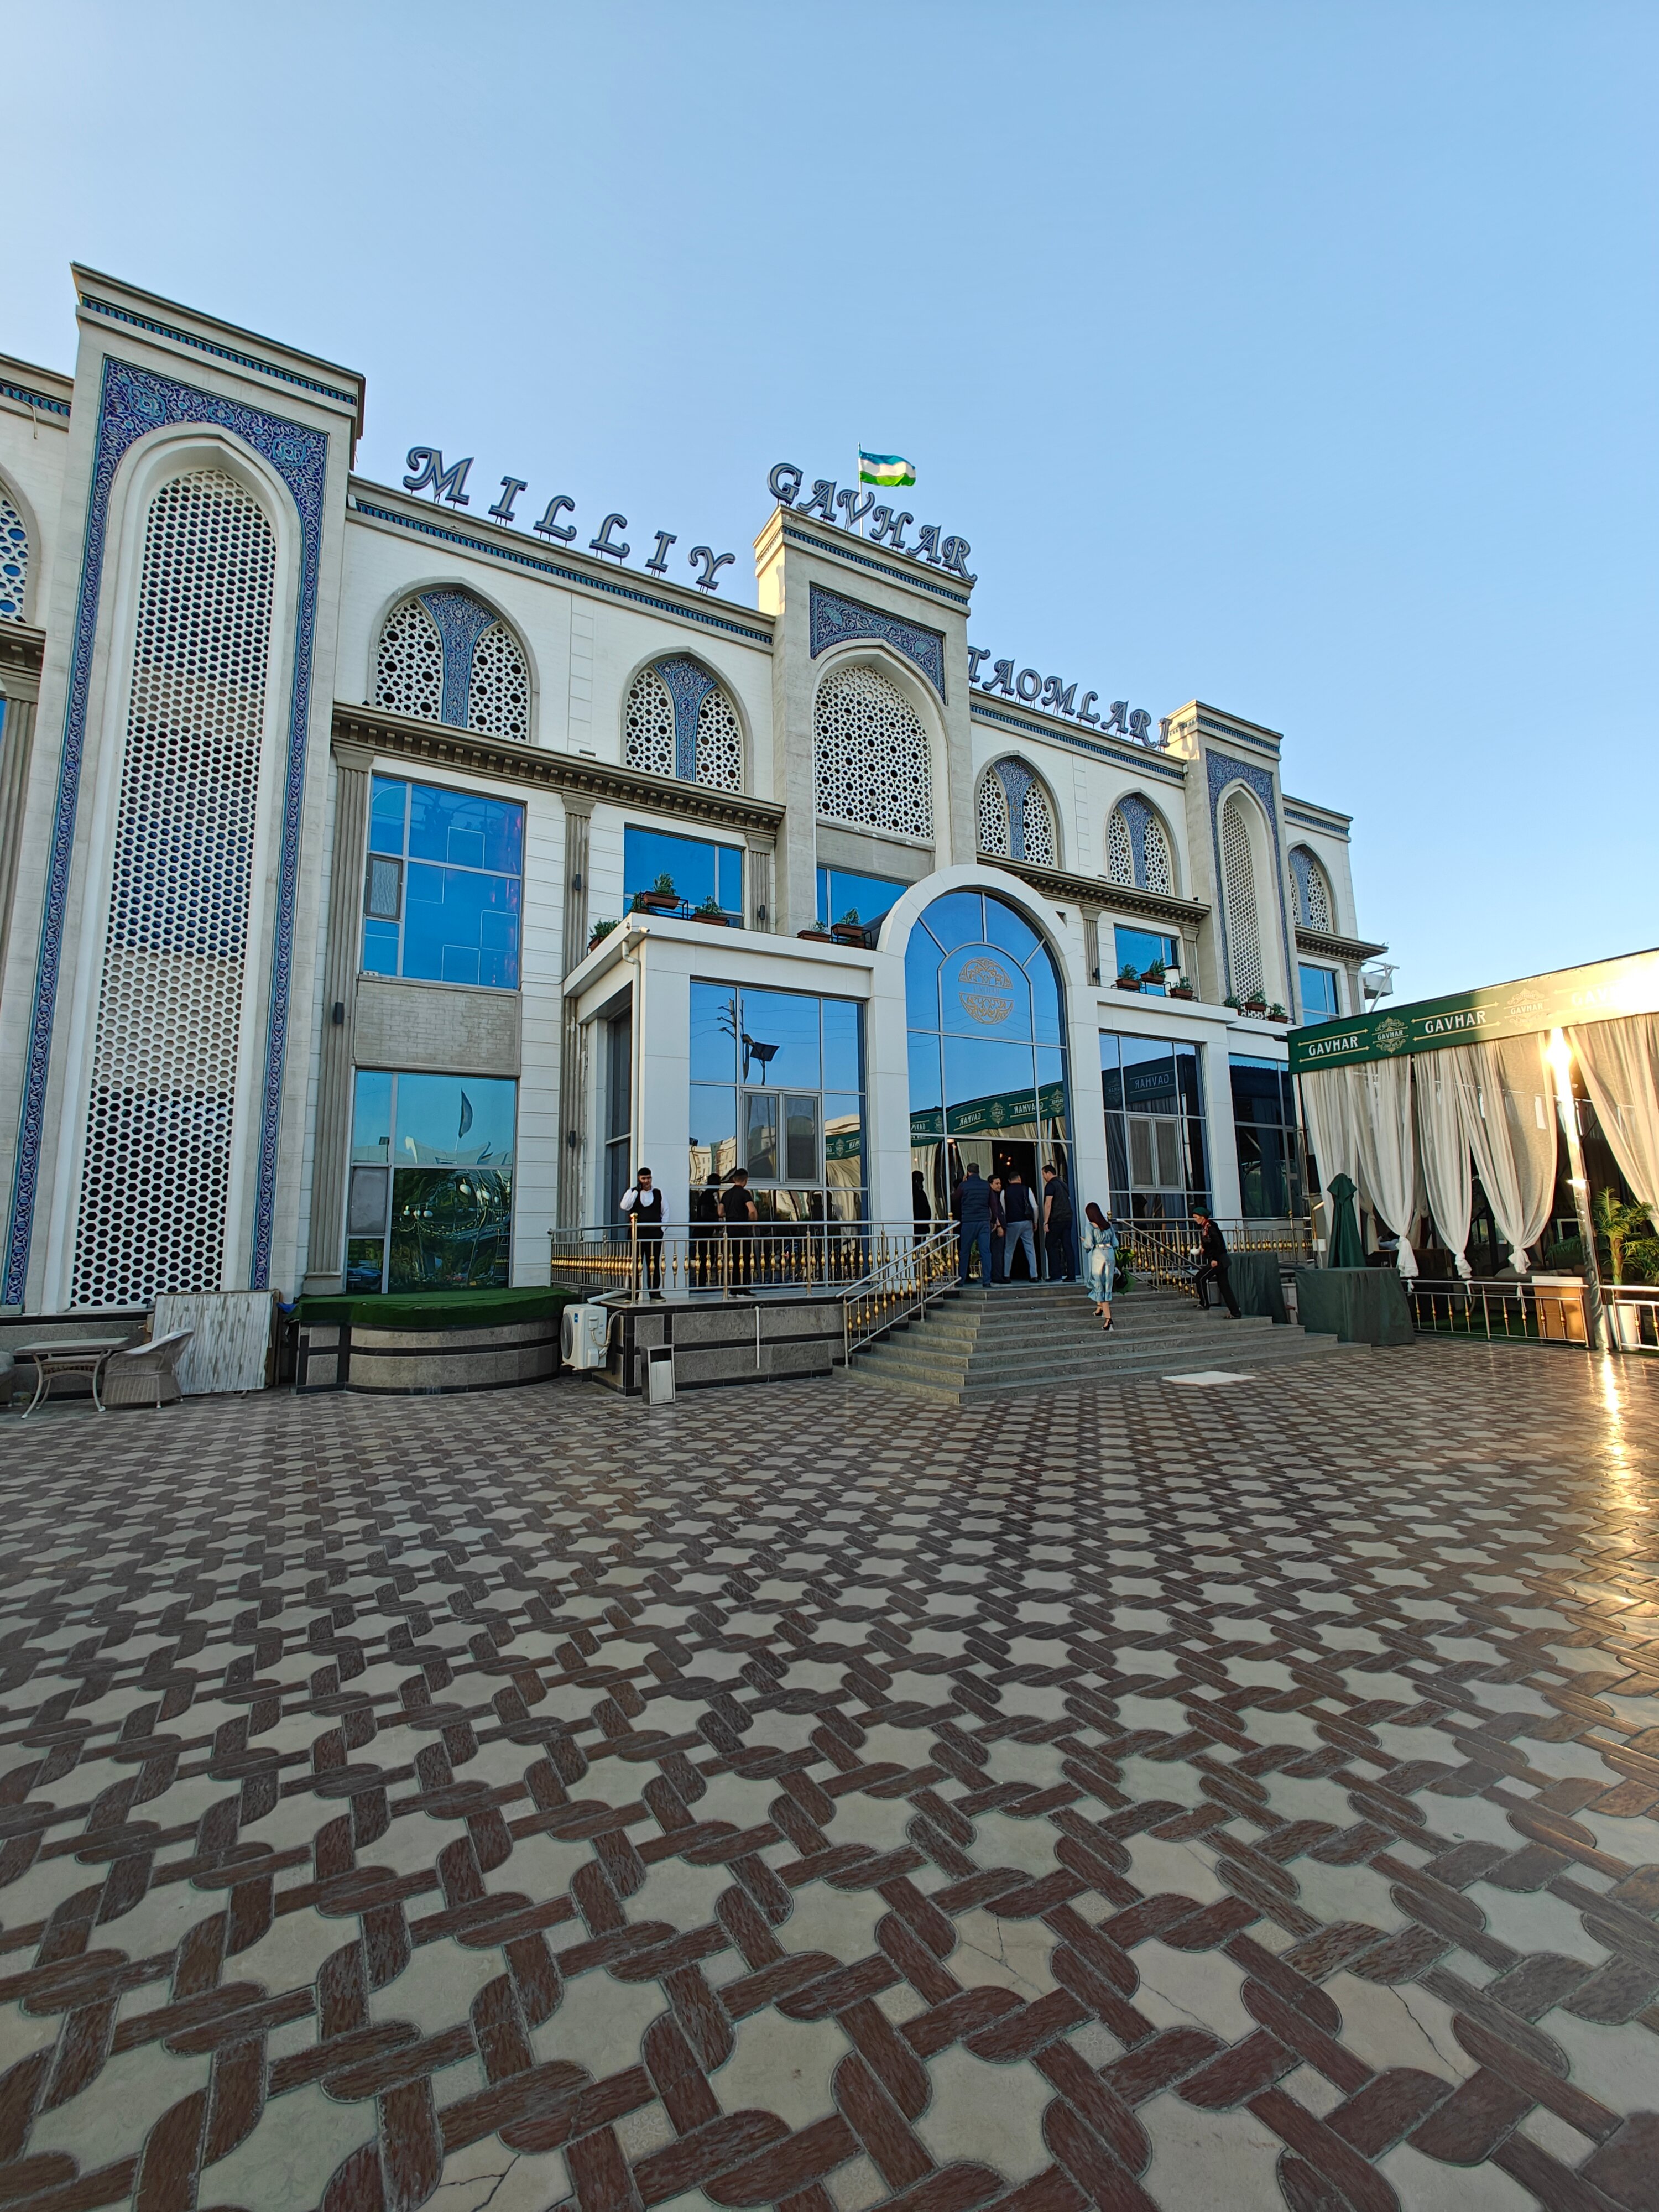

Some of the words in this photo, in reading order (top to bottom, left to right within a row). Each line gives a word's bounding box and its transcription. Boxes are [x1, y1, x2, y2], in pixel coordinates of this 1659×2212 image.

[402, 446, 735, 590] MILLIY
[767, 462, 978, 583] GAVHAR
[968, 646, 1173, 748] TAOMLARI
[1511, 1003, 1543, 1015] GAVHAR
[1425, 1010, 1487, 1034] GAVHAR
[1308, 1036, 1358, 1056] GAVHAR
[1377, 1030, 1404, 1040] GAVHAR
